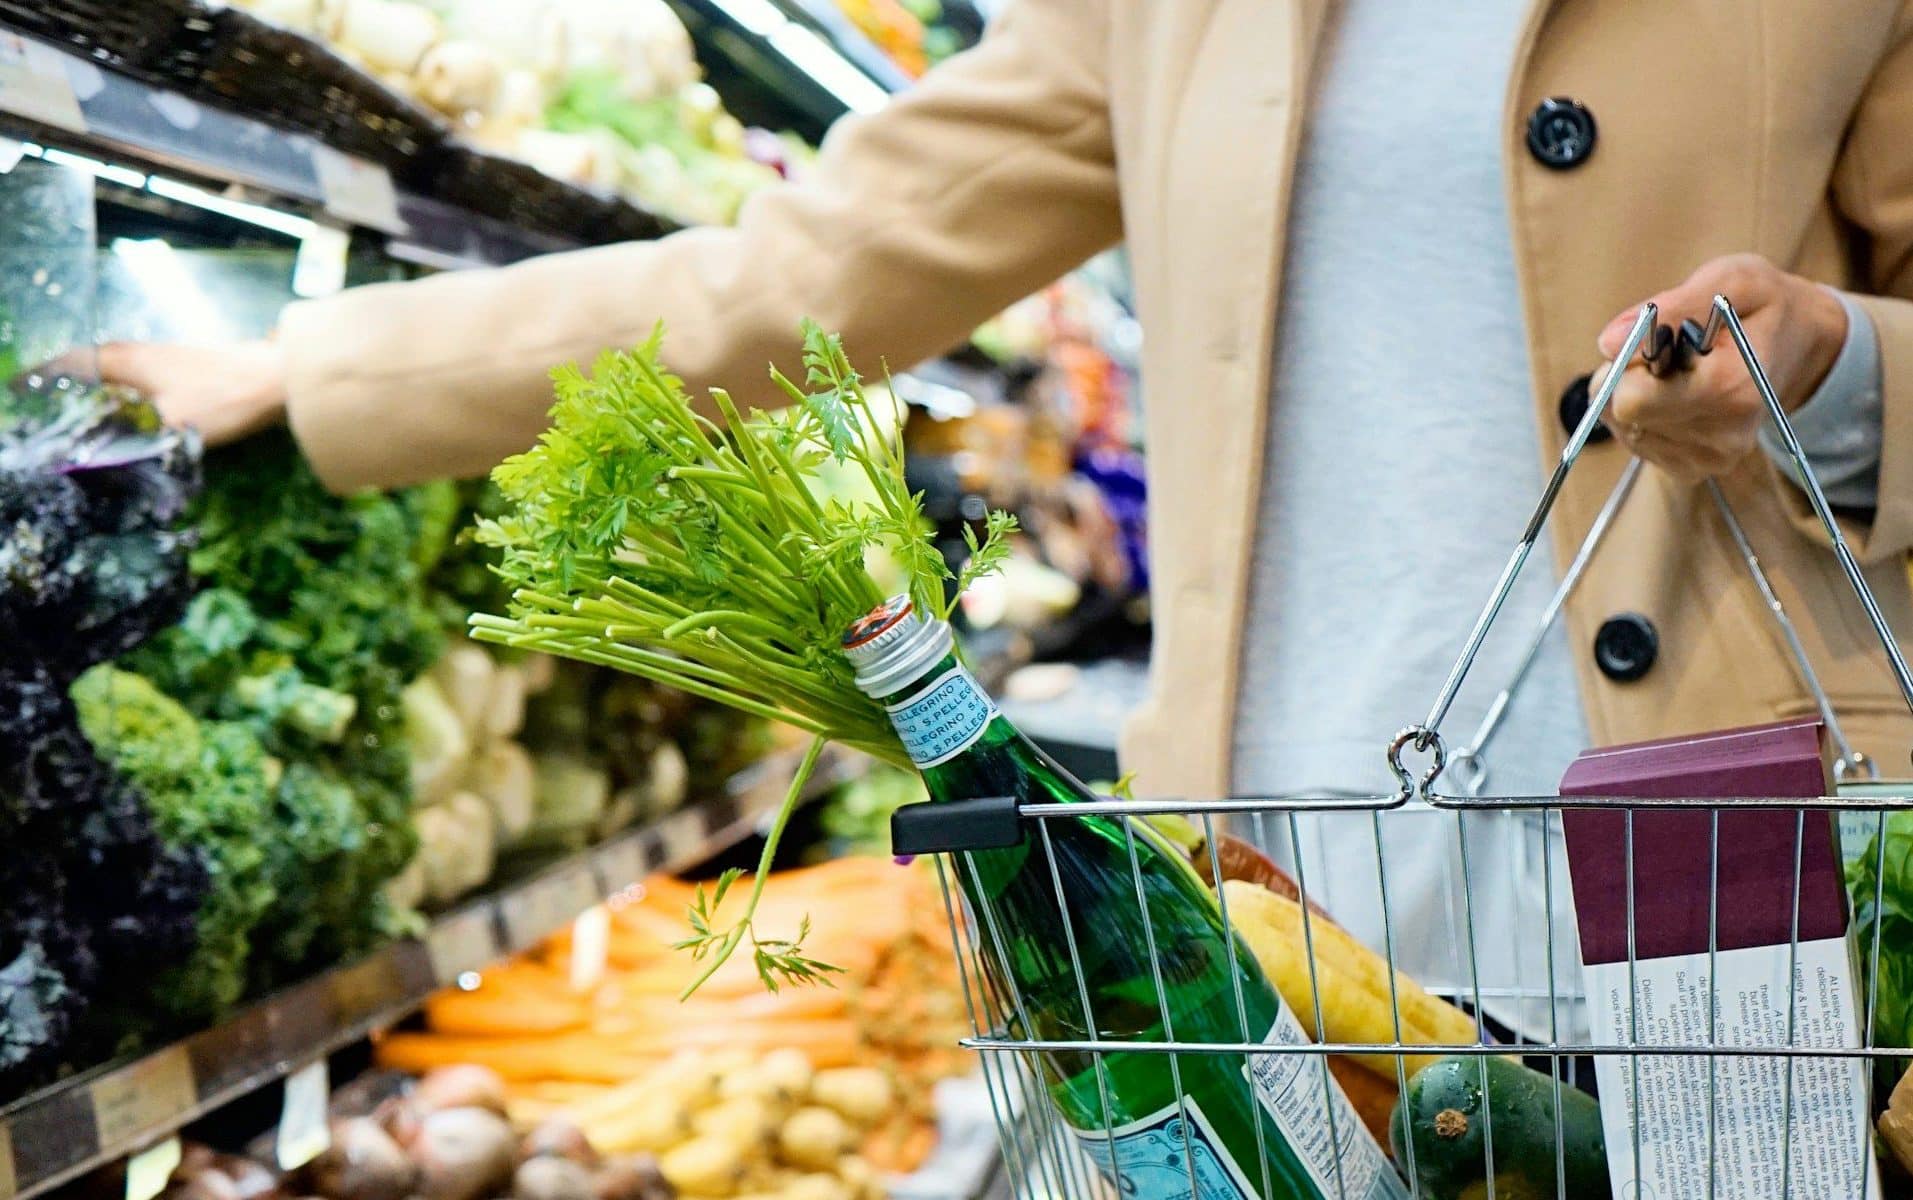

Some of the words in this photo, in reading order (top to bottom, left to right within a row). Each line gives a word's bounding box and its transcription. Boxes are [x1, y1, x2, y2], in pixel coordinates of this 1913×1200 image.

[1676, 970, 1686, 992] Seul
[1698, 975, 1707, 987] de
[1816, 966, 1830, 1008] delicious
[1829, 974, 1838, 985] At
[1610, 988, 1620, 1010] vous
[1679, 994, 1686, 1006] un
[1688, 984, 1698, 1008] avec
[1749, 990, 1758, 1005] but
[1759, 984, 1770, 1010] these
[1828, 987, 1843, 1019] Lesley
[1738, 990, 1750, 1025] cheese
[1774, 1009, 1783, 1017] A
[1799, 1005, 1808, 1021] her
[1614, 1013, 1622, 1025] ne
[1648, 1024, 1655, 1036] au
[1679, 1008, 1692, 1041] produit
[1749, 1008, 1762, 1033] really
[1761, 1012, 1774, 1045] unique
[1811, 1018, 1820, 1033] are
[1657, 1017, 1673, 1069] CRAEZ
[1715, 1022, 1727, 1048] Stow
[1743, 1027, 1750, 1037] or
[1802, 1023, 1812, 1047] team
[1814, 1036, 1824, 1062] me
[1825, 1035, 1837, 1064] The
[1620, 1065, 1630, 1084] plus
[1642, 1064, 1650, 1075] de
[1676, 1055, 1688, 1089] pouvait
[1759, 1063, 1769, 1088] when
[1795, 1063, 1808, 1097] scratch
[1818, 1065, 1828, 1084] with
[1654, 1075, 1662, 1092] ces
[1665, 1070, 1677, 1101] POUR
[1723, 1076, 1735, 1105] Foods
[1808, 1075, 1818, 1090] the
[1829, 1067, 1842, 1106] fabulous
[1842, 1076, 1854, 1106] Foods
[1739, 1088, 1748, 1103] are
[1751, 1086, 1760, 1102] We
[1809, 1092, 1820, 1112] only
[1821, 1086, 1830, 1107] care
[1669, 1103, 1680, 1125] CES
[1681, 1091, 1694, 1132] satisfaire
[1714, 1096, 1727, 1136] fabuleux
[1742, 1105, 1752, 1126] sure
[1761, 1090, 1774, 1122] topped
[1799, 1099, 1810, 1124] using
[1824, 1109, 1832, 1118] in
[1846, 1108, 1854, 1122] we
[1657, 1094, 1671, 1141] craquelins
[1727, 1107, 1738, 1134] adore
[1811, 1114, 1822, 1133] way
[1833, 1108, 1845, 1137] crisps
[1651, 1127, 1659, 1139] de
[1673, 1127, 1684, 1152] FINS
[1695, 1119, 1705, 1142] avec
[1744, 1129, 1754, 1146] you
[1755, 1121, 1768, 1162] addicted
[1767, 1124, 1777, 1143] with
[1803, 1126, 1812, 1142] our
[1816, 1135, 1824, 1144] to
[1825, 1120, 1836, 1145] small
[1848, 1124, 1858, 1145] love
[1651, 1141, 1665, 1179] fromage
[1664, 1143, 1674, 1164] sont
[1686, 1134, 1698, 1164] Lesley
[1699, 1143, 1709, 1161] des
[1730, 1137, 1744, 1178] fabriquer
[1748, 1148, 1757, 1163] will
[1766, 1145, 1779, 1166] your
[1806, 1144, 1817, 1169] finest
[1818, 1147, 1828, 1173] make
[1839, 1138, 1850, 1160] from
[1691, 1167, 1699, 1176] et
[1720, 1137, 1734, 1186] craquelins
[1750, 1165, 1759, 1177] be
[1761, 1164, 1768, 1174] to
[1847, 1146, 1862, 1181] making
[1658, 1181, 1666, 1194] ou
[1693, 1178, 1702, 1196] son
[1737, 1180, 1745, 1189] et
[1763, 1175, 1772, 1192] this
